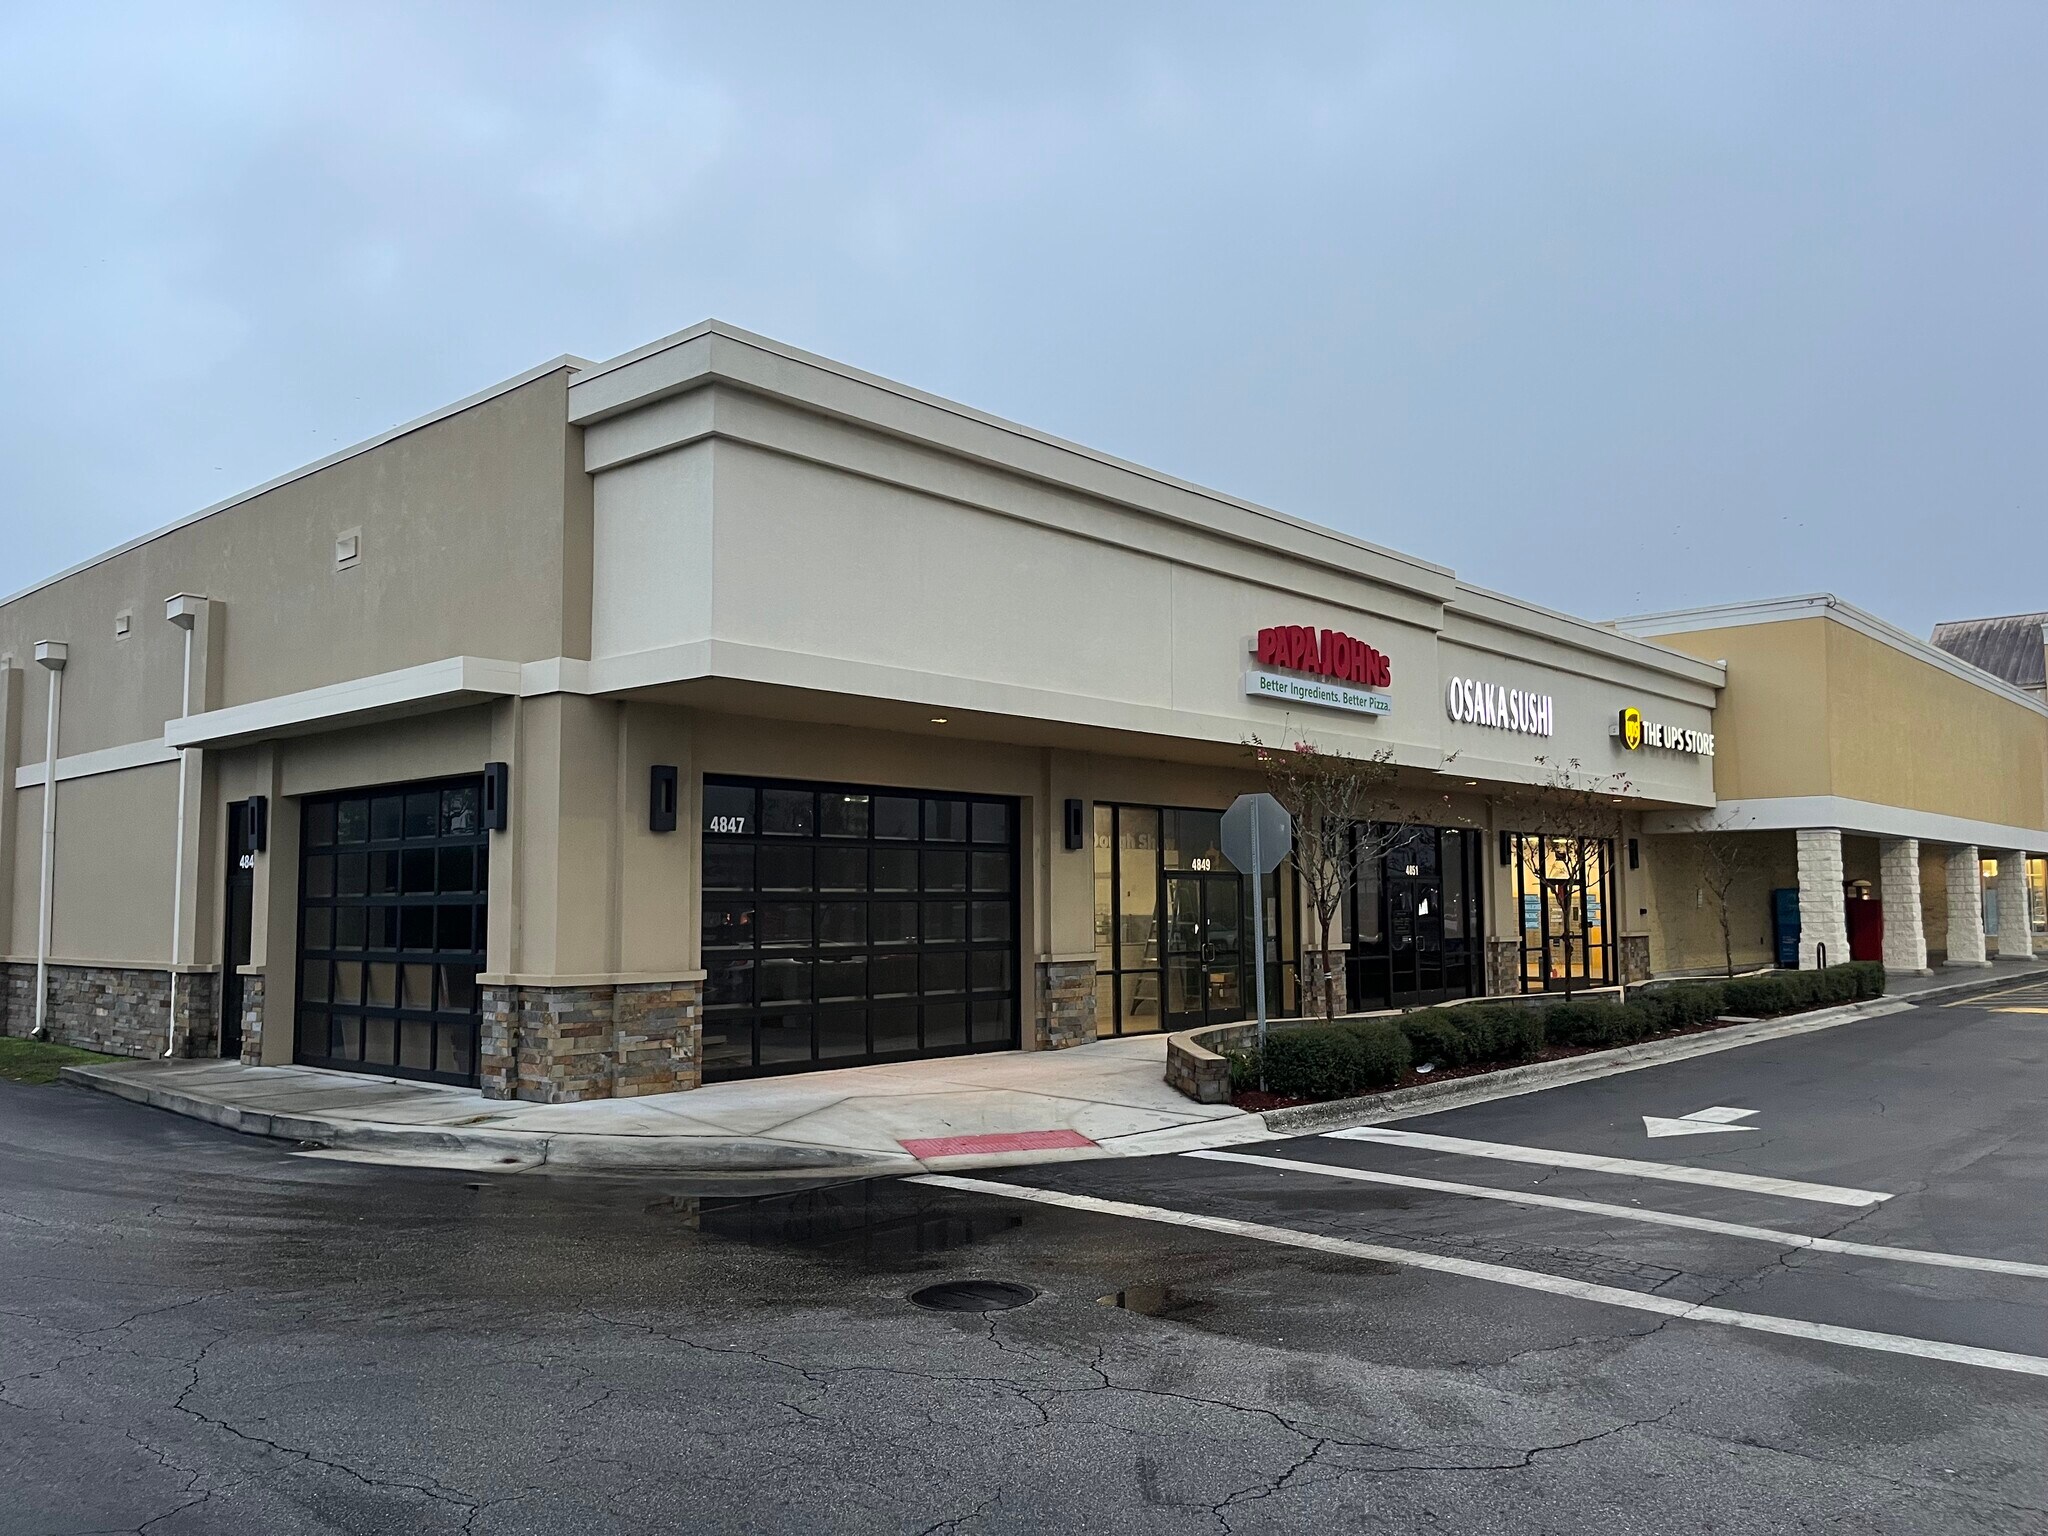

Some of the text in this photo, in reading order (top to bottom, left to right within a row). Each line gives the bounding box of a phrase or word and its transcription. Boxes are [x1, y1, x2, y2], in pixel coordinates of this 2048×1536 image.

[1259, 676, 1391, 712] Better Ingredients. Better Pizza.
[1449, 676, 1553, 737] OSAKA SUSHI
[1642, 720, 1715, 756] THE UPS STORE
[710, 815, 745, 833] 4847
[1094, 832, 1175, 850] ogh Shw
[239, 854, 254, 869] 484
[1191, 858, 1211, 871] 4849
